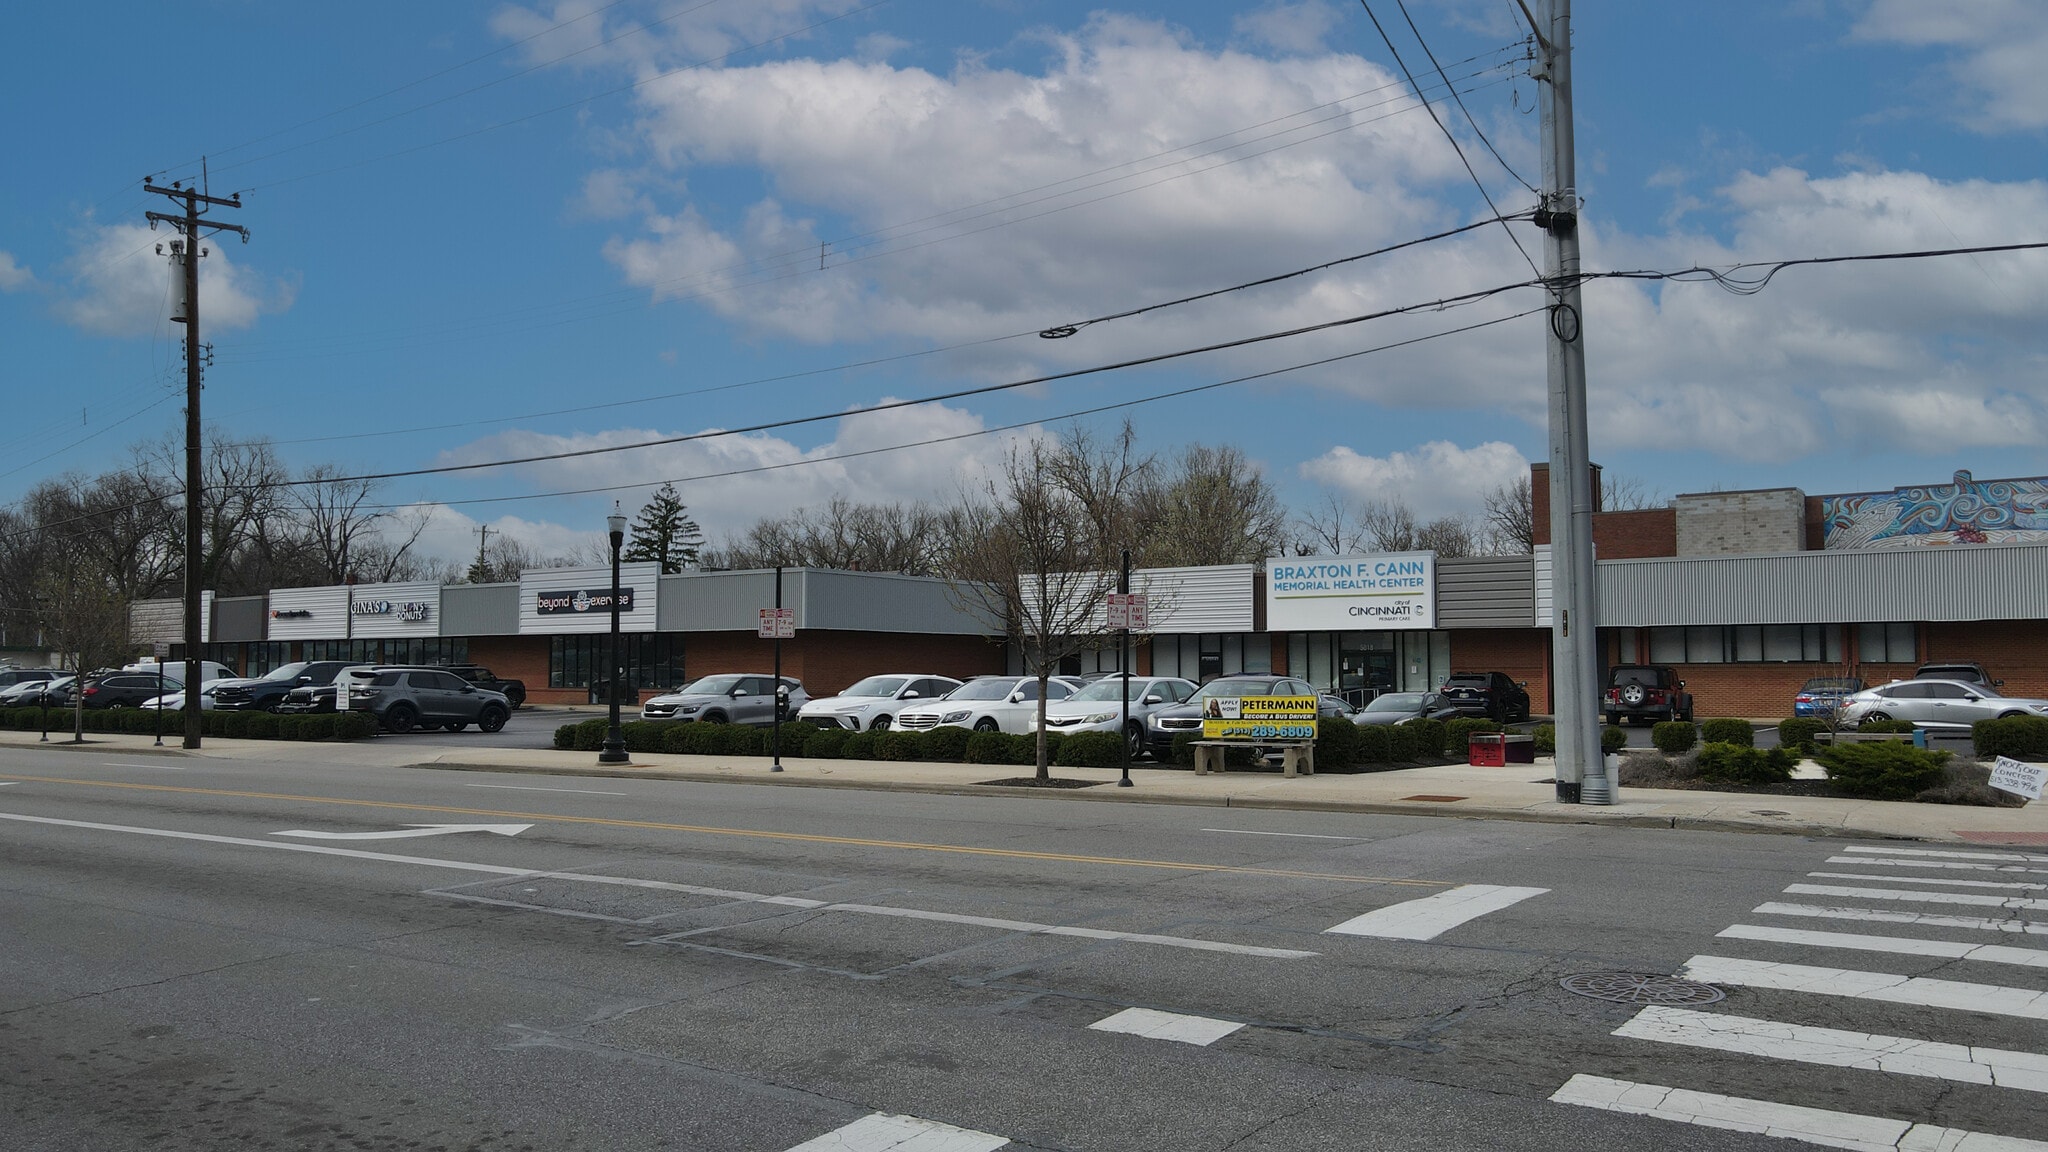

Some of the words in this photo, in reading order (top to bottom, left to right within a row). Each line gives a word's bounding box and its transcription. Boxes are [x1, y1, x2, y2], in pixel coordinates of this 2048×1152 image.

[1274, 564, 1351, 580] BRAXTON
[1357, 563, 1369, 576] F.
[1375, 561, 1424, 577] CANN
[1274, 581, 1330, 592] MEMORIAL
[1334, 578, 1376, 590] HEALTH
[1379, 577, 1424, 588] CENTER
[351, 601, 380, 614] GINA'S
[538, 595, 570, 611] beyond
[590, 595, 629, 606] exerse
[396, 611, 423, 620] DONUTS
[1348, 606, 1411, 616] CINCINNATI
[1242, 700, 1315, 710] PETERMANN
[1252, 725, 1313, 738] 289-6809
[1996, 757, 2022, 773] KNOCK
[2023, 766, 2041, 775] OUT
